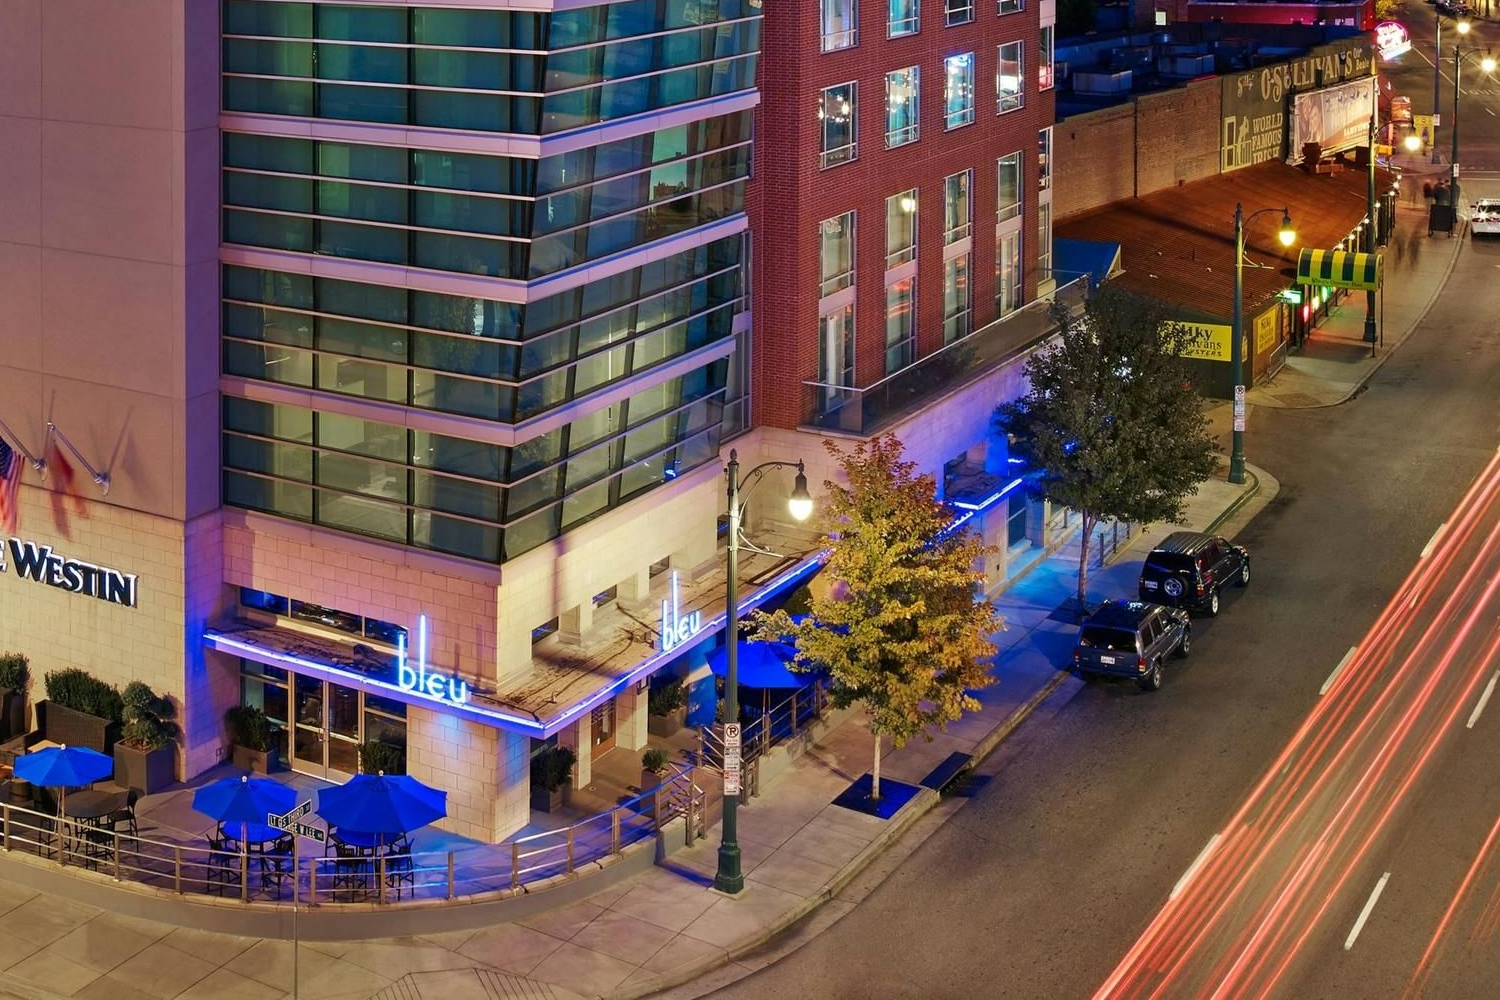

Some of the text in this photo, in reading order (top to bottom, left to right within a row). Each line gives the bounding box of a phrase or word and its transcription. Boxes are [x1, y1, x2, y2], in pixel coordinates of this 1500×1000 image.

[1253, 112, 1283, 134] WORLD
[1252, 128, 1283, 151] FAMOUS
[8, 536, 140, 609] WESTIN
[661, 569, 701, 651] bleu
[398, 614, 468, 705] bleu
[270, 816, 276, 825] LT
[305, 826, 316, 839] LEE
[282, 818, 287, 827] S
[288, 806, 304, 824] THIRD
